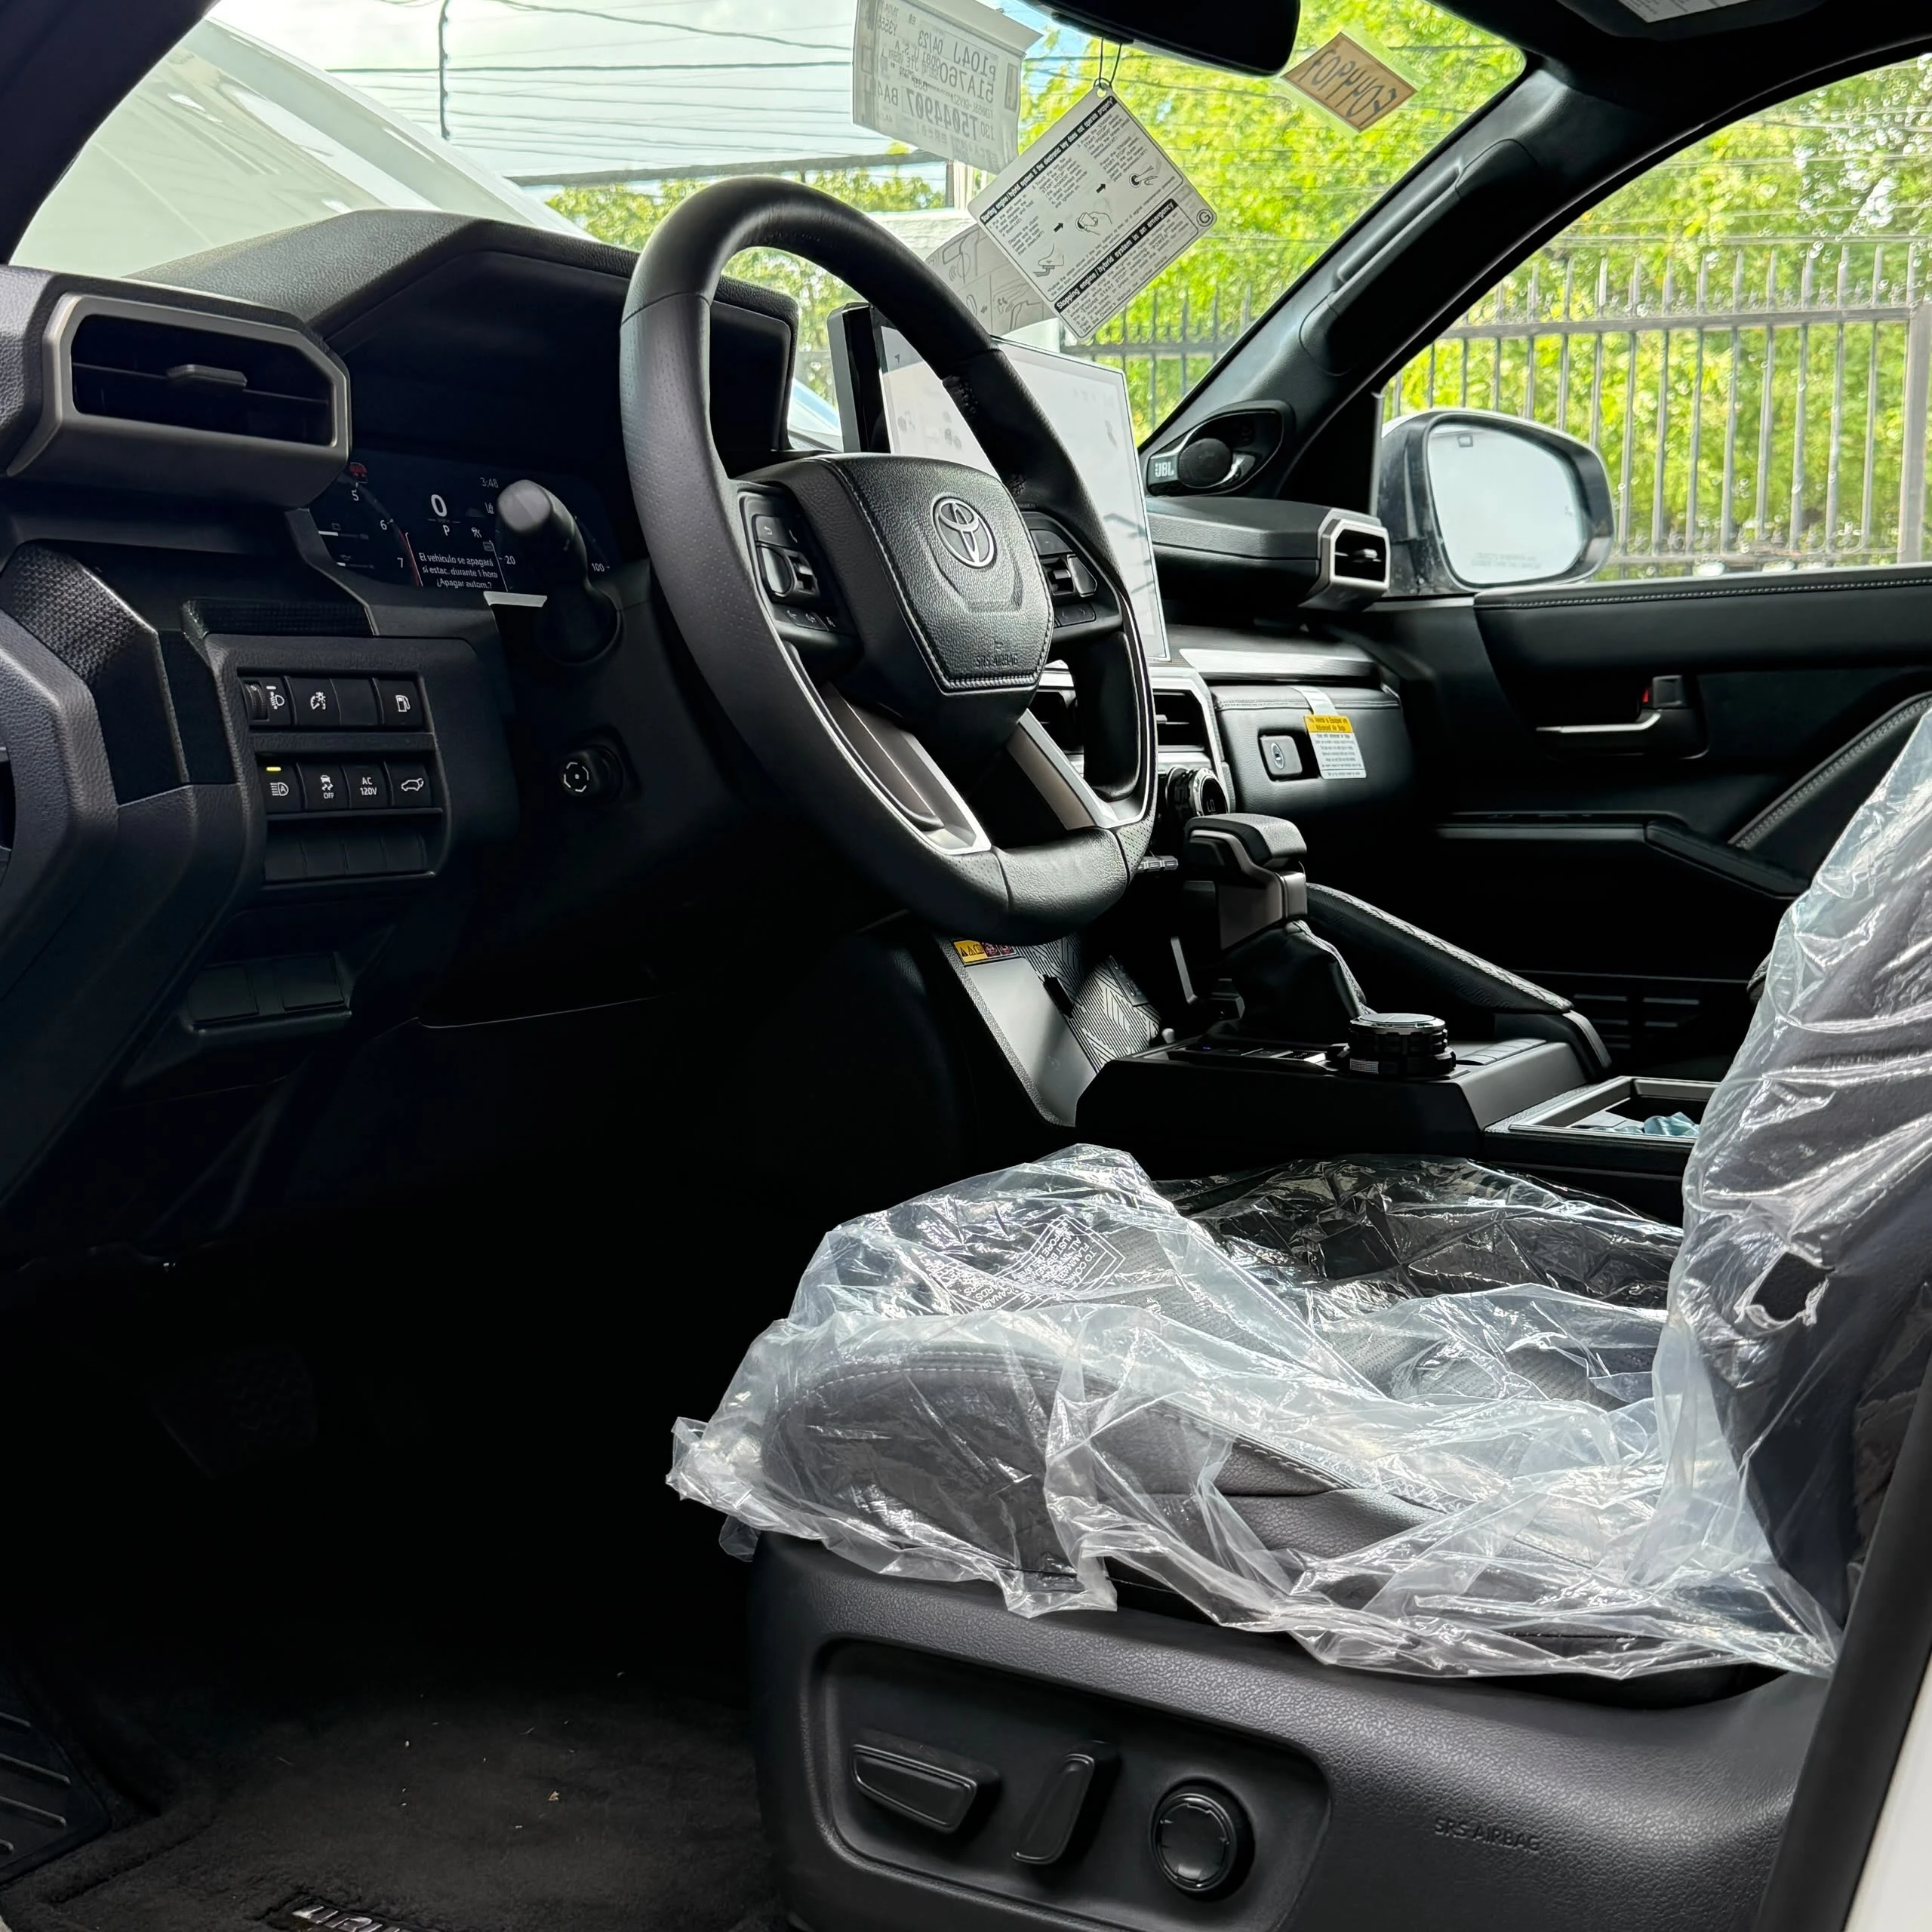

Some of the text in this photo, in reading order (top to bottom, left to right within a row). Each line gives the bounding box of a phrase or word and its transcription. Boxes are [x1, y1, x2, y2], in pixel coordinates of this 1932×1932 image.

[1056, 287, 1081, 311] Stopping
[1112, 238, 1134, 259] system
[1131, 232, 1140, 242] in
[1138, 226, 1148, 235] an
[1146, 201, 1176, 229] emergency
[1155, 461, 1174, 477] JBL
[352, 491, 359, 501] 5
[431, 494, 448, 517] 0
[380, 519, 388, 531] 6
[442, 525, 450, 536] P
[397, 557, 404, 568] 7
[504, 555, 515, 565] 20
[592, 563, 605, 572] 100
[360, 787, 377, 795] 120V
[1435, 1817, 1541, 1854] SRS AIRBAG
